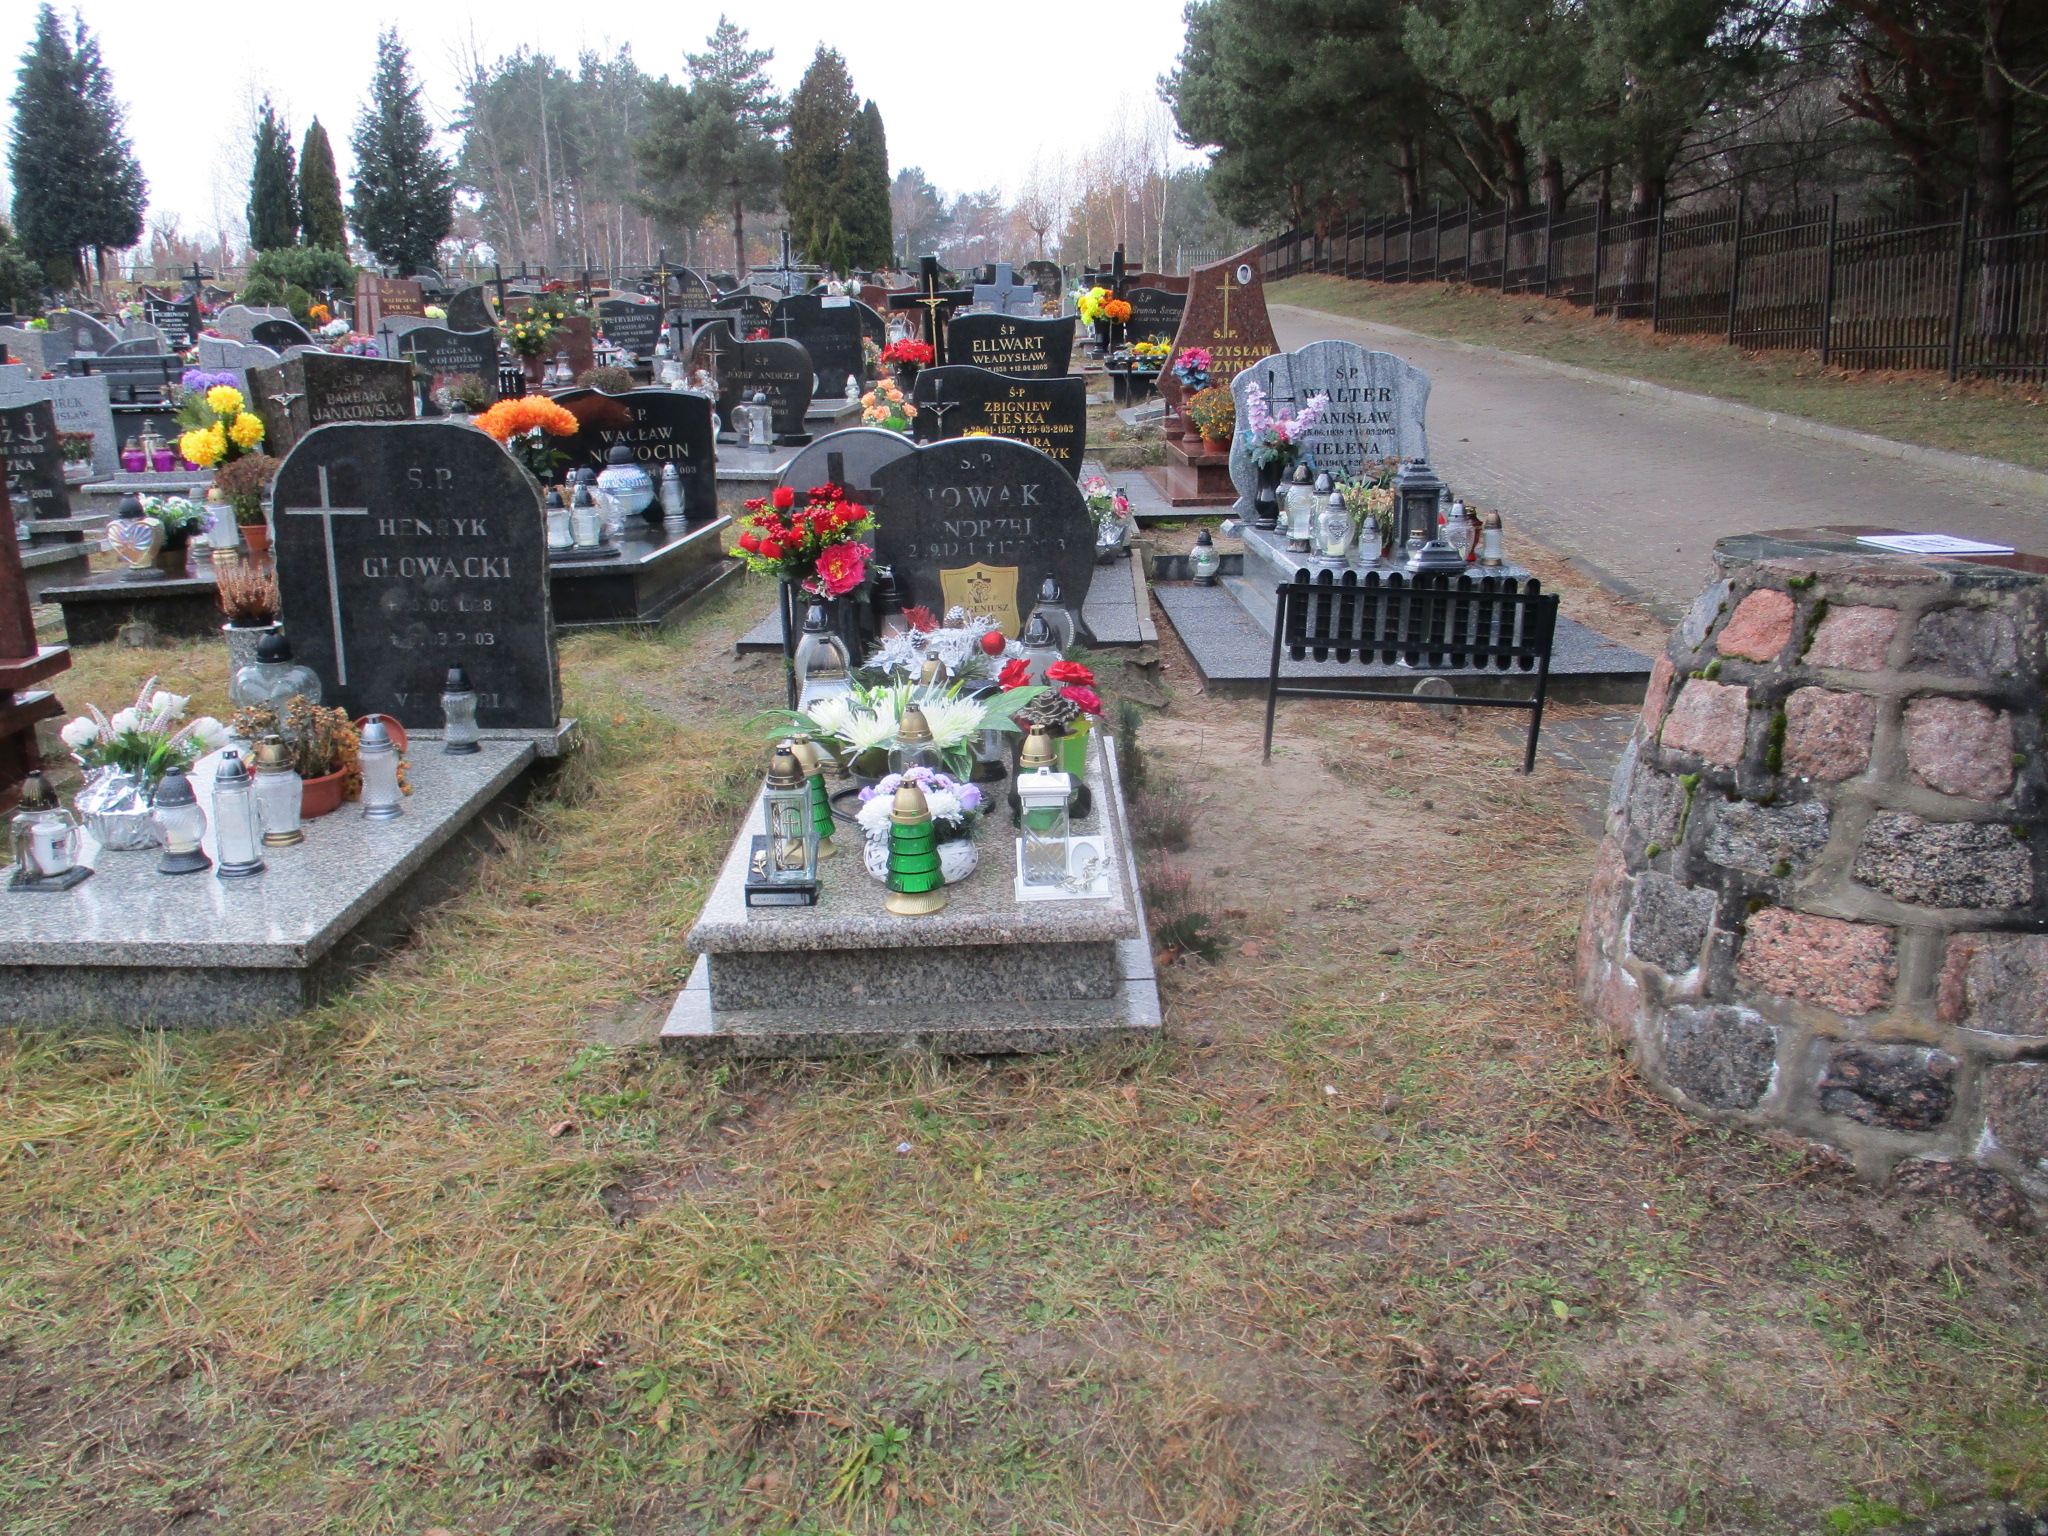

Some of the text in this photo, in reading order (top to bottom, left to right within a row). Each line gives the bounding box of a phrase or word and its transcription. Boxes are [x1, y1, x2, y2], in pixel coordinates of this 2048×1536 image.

[972, 336, 1044, 352] ELLWART
[972, 352, 1046, 364] WŁADYSŁAW
[726, 367, 800, 380] JÓZEF ANDRZEJ
[326, 391, 387, 405] BARBARA
[1303, 388, 1392, 402] WALTER
[313, 404, 405, 421] JANKOWSKA
[984, 401, 1052, 412] ZBIGNIEW
[990, 412, 1045, 425] TESKA
[600, 427, 673, 443] WACŁAW
[378, 518, 487, 536] HENRYK
